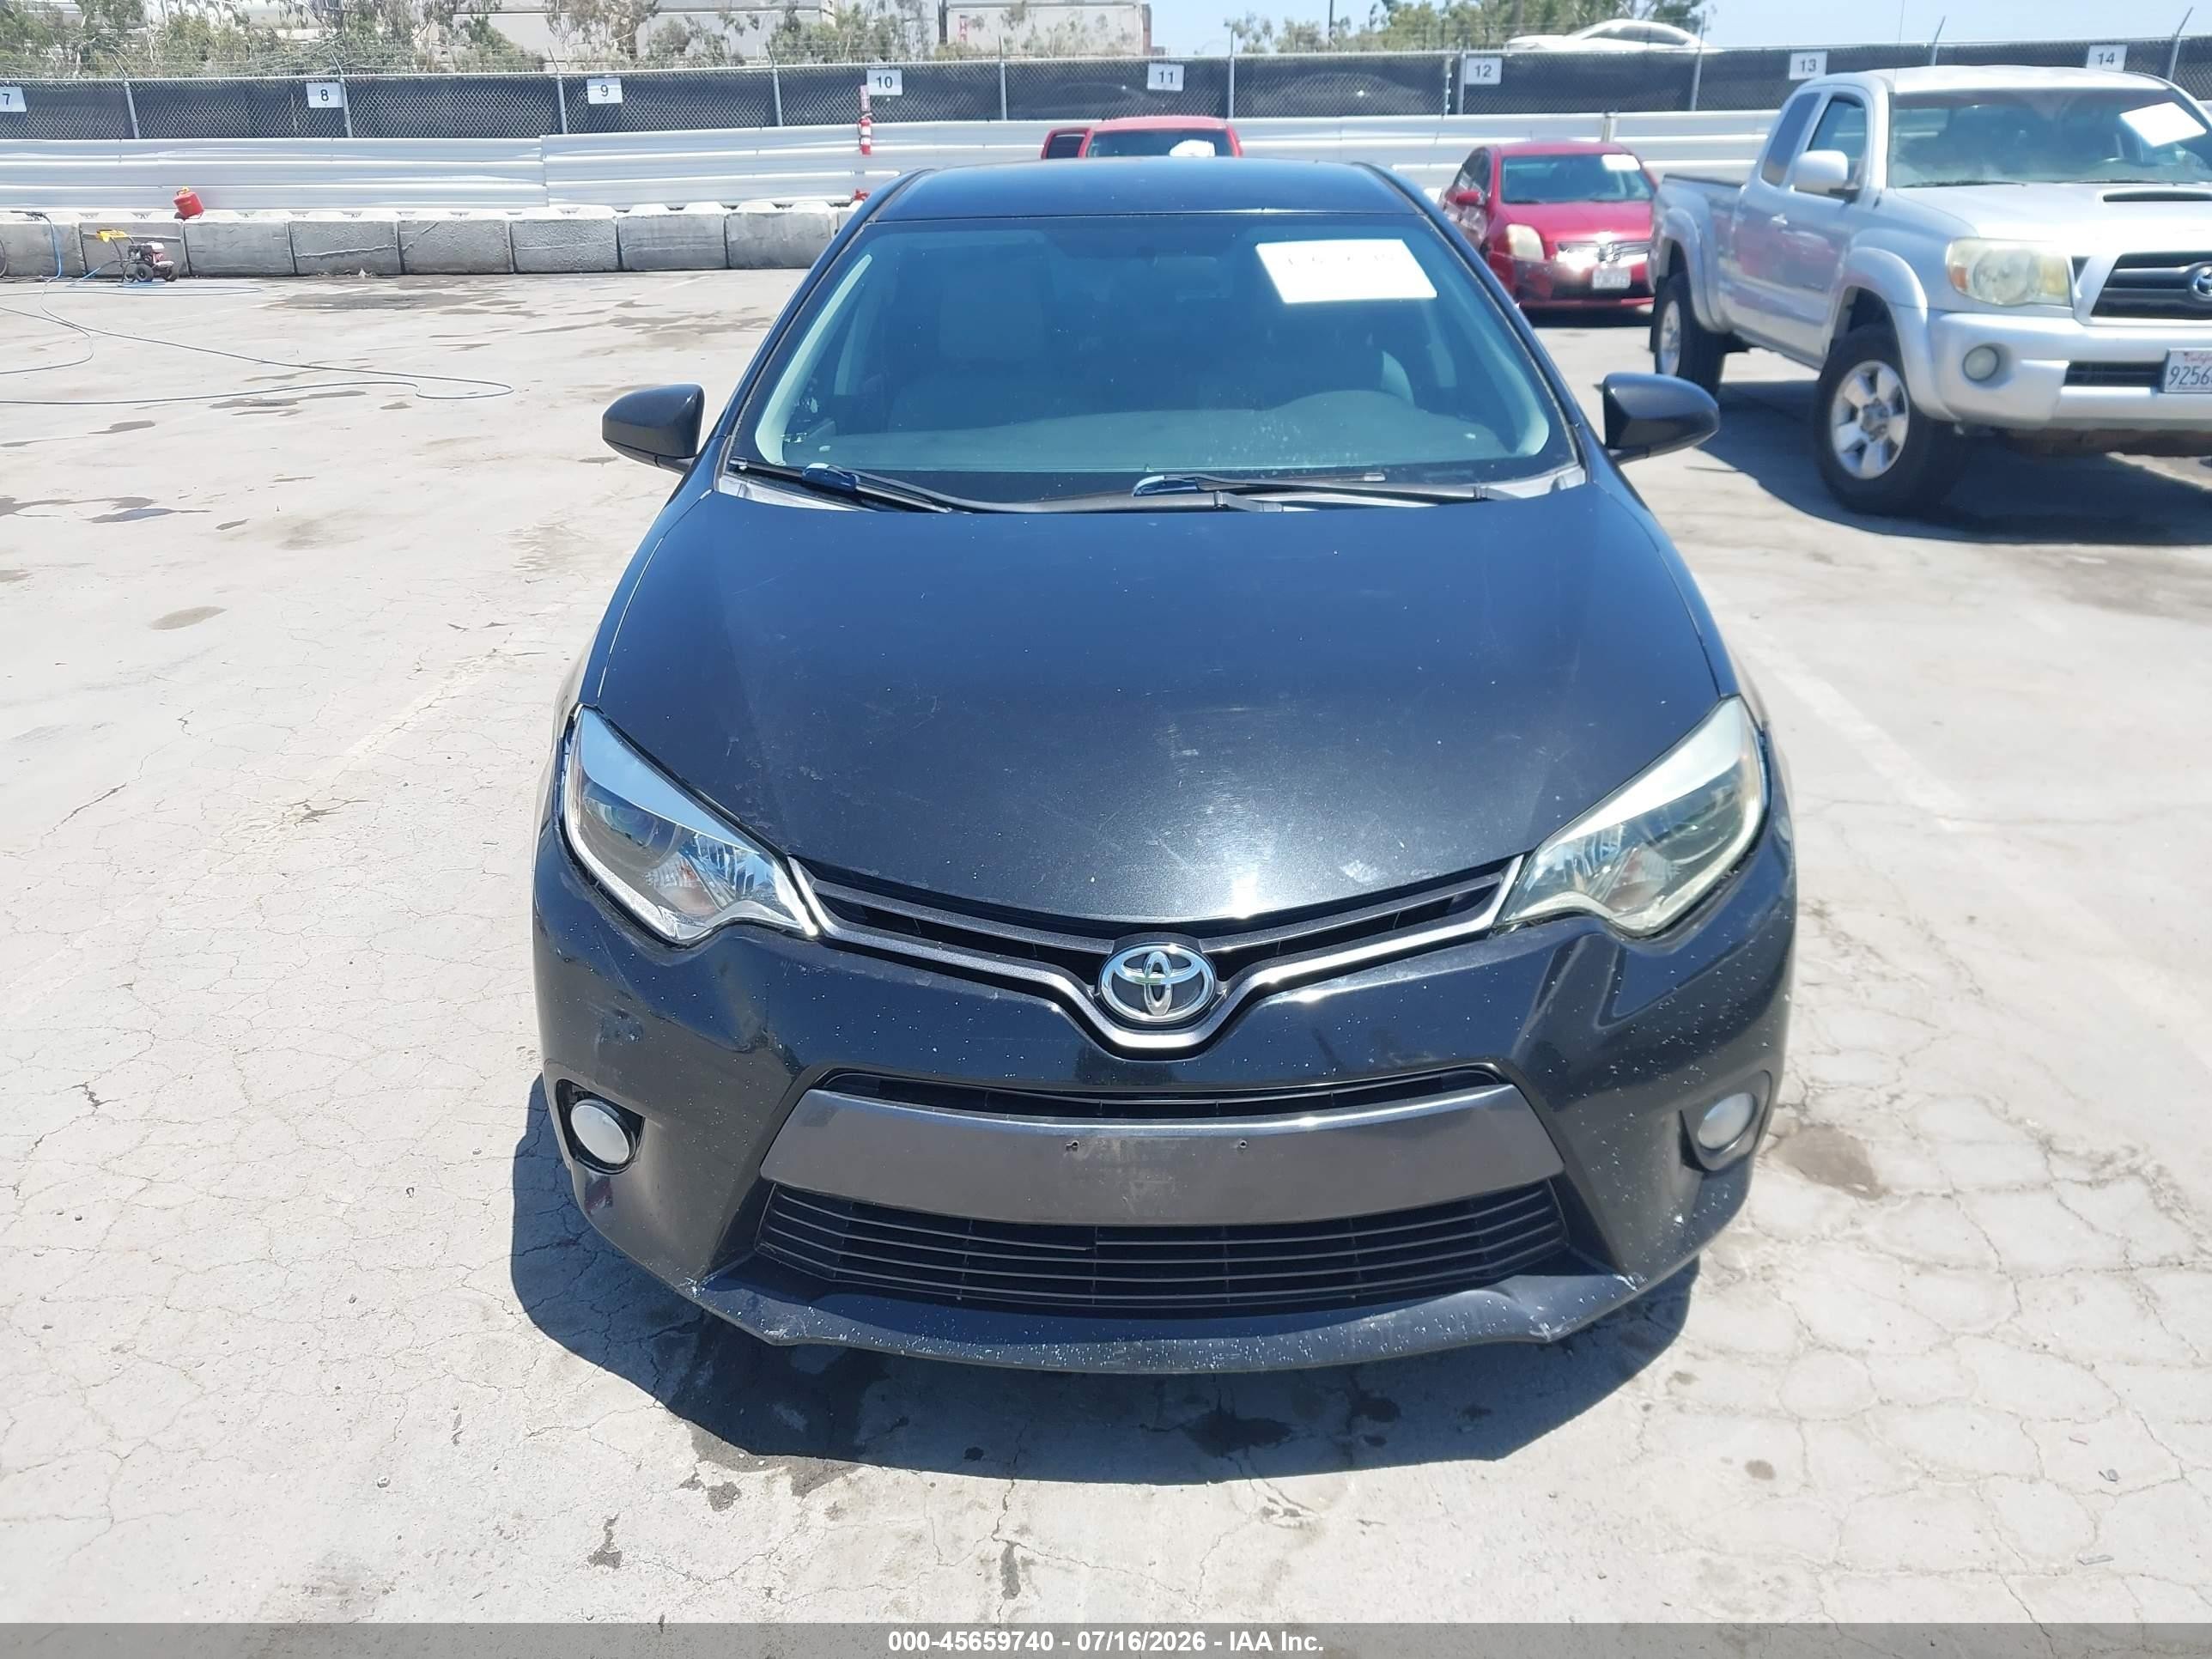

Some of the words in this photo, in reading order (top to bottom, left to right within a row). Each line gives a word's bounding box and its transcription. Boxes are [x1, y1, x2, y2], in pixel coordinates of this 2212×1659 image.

[1800, 58, 1817, 72] 13
[2098, 52, 2115, 65] 14
[1158, 70, 1175, 83] 11
[1474, 64, 1492, 77] 12
[876, 76, 893, 88] 10
[320, 88, 330, 101] 8
[600, 83, 609, 97] 9
[2, 93, 10, 106] 7
[2168, 365, 2212, 386] 9256
